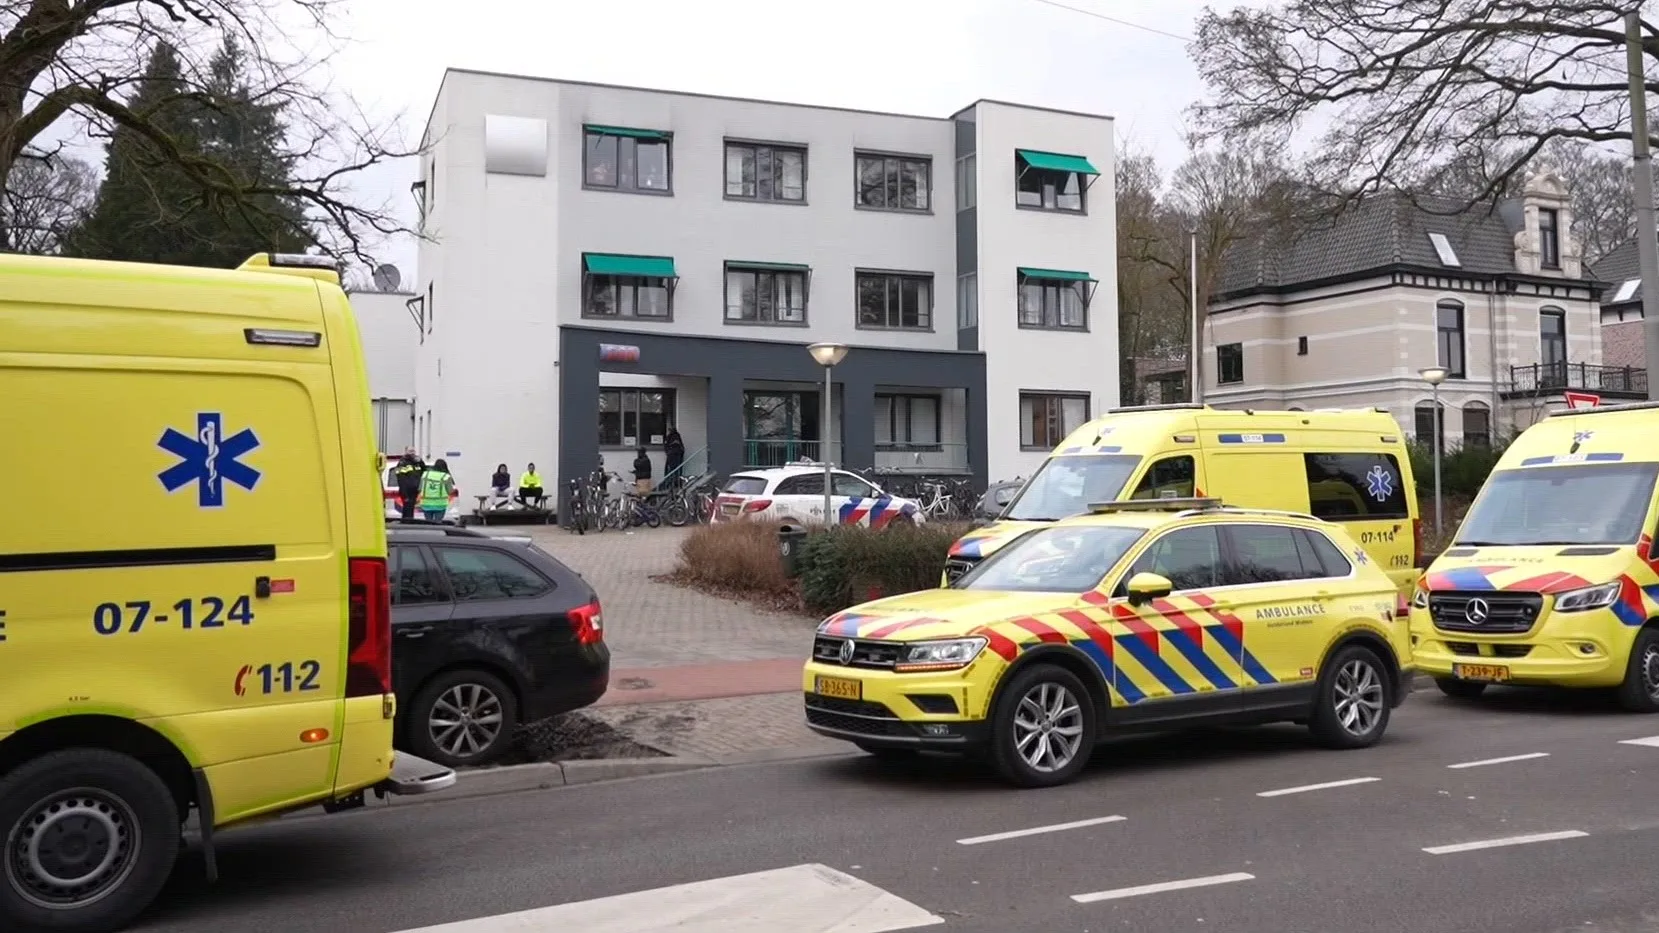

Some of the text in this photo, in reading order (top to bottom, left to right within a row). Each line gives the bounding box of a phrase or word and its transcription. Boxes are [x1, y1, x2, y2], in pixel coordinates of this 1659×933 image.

[1361, 531, 1394, 544] 07-114
[93, 595, 255, 635] 07-124
[1256, 603, 1326, 619] AMBULANCE
